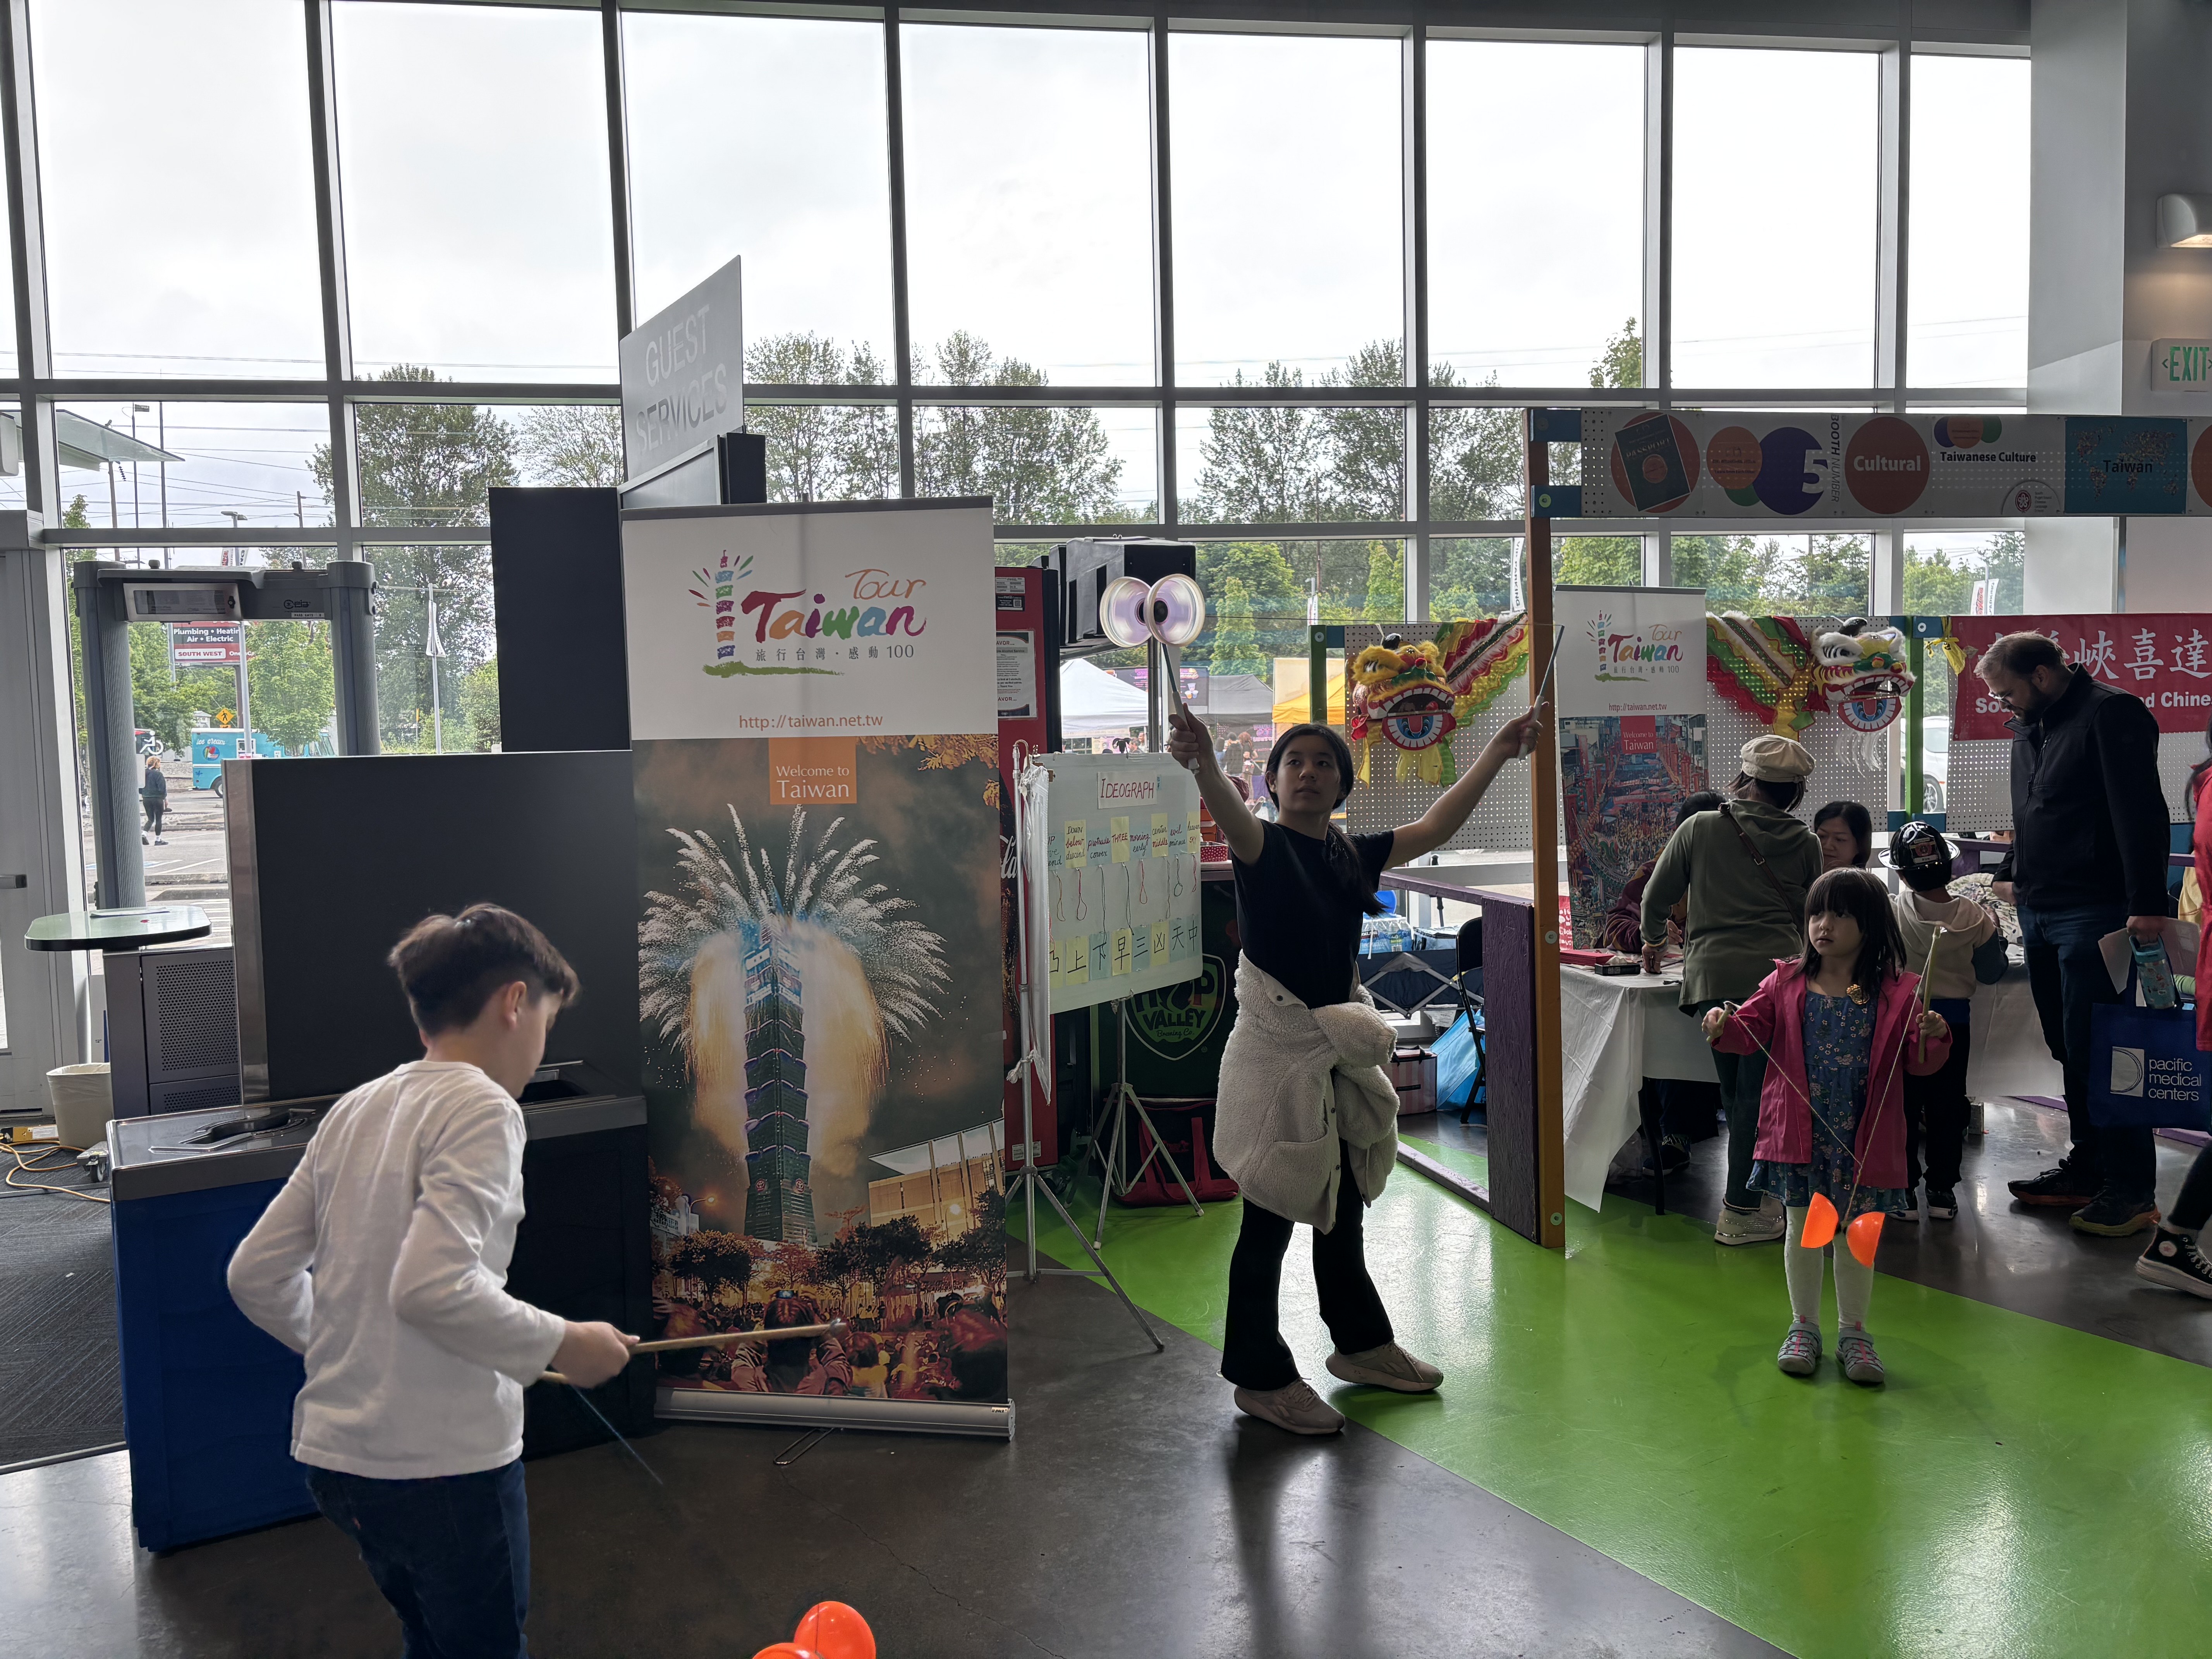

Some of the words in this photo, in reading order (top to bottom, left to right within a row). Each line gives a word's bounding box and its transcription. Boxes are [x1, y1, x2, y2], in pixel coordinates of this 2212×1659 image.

[646, 304, 709, 387] GUEST
[2169, 346, 2209, 381] EXIT
[636, 363, 727, 454] SERVICES
[1831, 414, 1840, 455] BOOTH
[1853, 455, 1921, 471] Cultural
[1940, 452, 1996, 462] Taiwanese
[1999, 452, 2036, 462] Culture
[1802, 449, 1829, 494] 5
[2103, 460, 2153, 473] Taiwan
[1831, 458, 1840, 502] NUMBER
[845, 568, 926, 600] Tour
[741, 589, 926, 643] Taiwan
[1649, 624, 1682, 641] Tour
[1607, 634, 1683, 663] Taiwan
[1609, 703, 1667, 712] http://taiwan.net.tw
[2161, 692, 2212, 708] Chine
[739, 714, 883, 731] http://taiwan.net.tw
[1624, 739, 1654, 750] Taiwan
[776, 765, 834, 776] Welcome
[837, 766, 850, 776] to
[776, 780, 849, 798] Taiwan
[1100, 778, 1154, 799] IDEOGRAPH
[1111, 833, 1128, 843] THREE
[1152, 825, 1167, 835] center
[1066, 836, 1084, 848] below
[1133, 843, 1146, 856] early
[1068, 950, 1086, 973] 上
[1115, 936, 1130, 970] 早
[1134, 936, 1148, 957] 三
[1154, 932, 1165, 954] 凶
[1172, 926, 1184, 951] 天
[1188, 920, 1197, 951] 中
[1143, 1008, 1206, 1030] VALLEY
[2149, 1058, 2192, 1072] pacific
[2149, 1073, 2202, 1086] medical
[2148, 1088, 2199, 1101] centers
